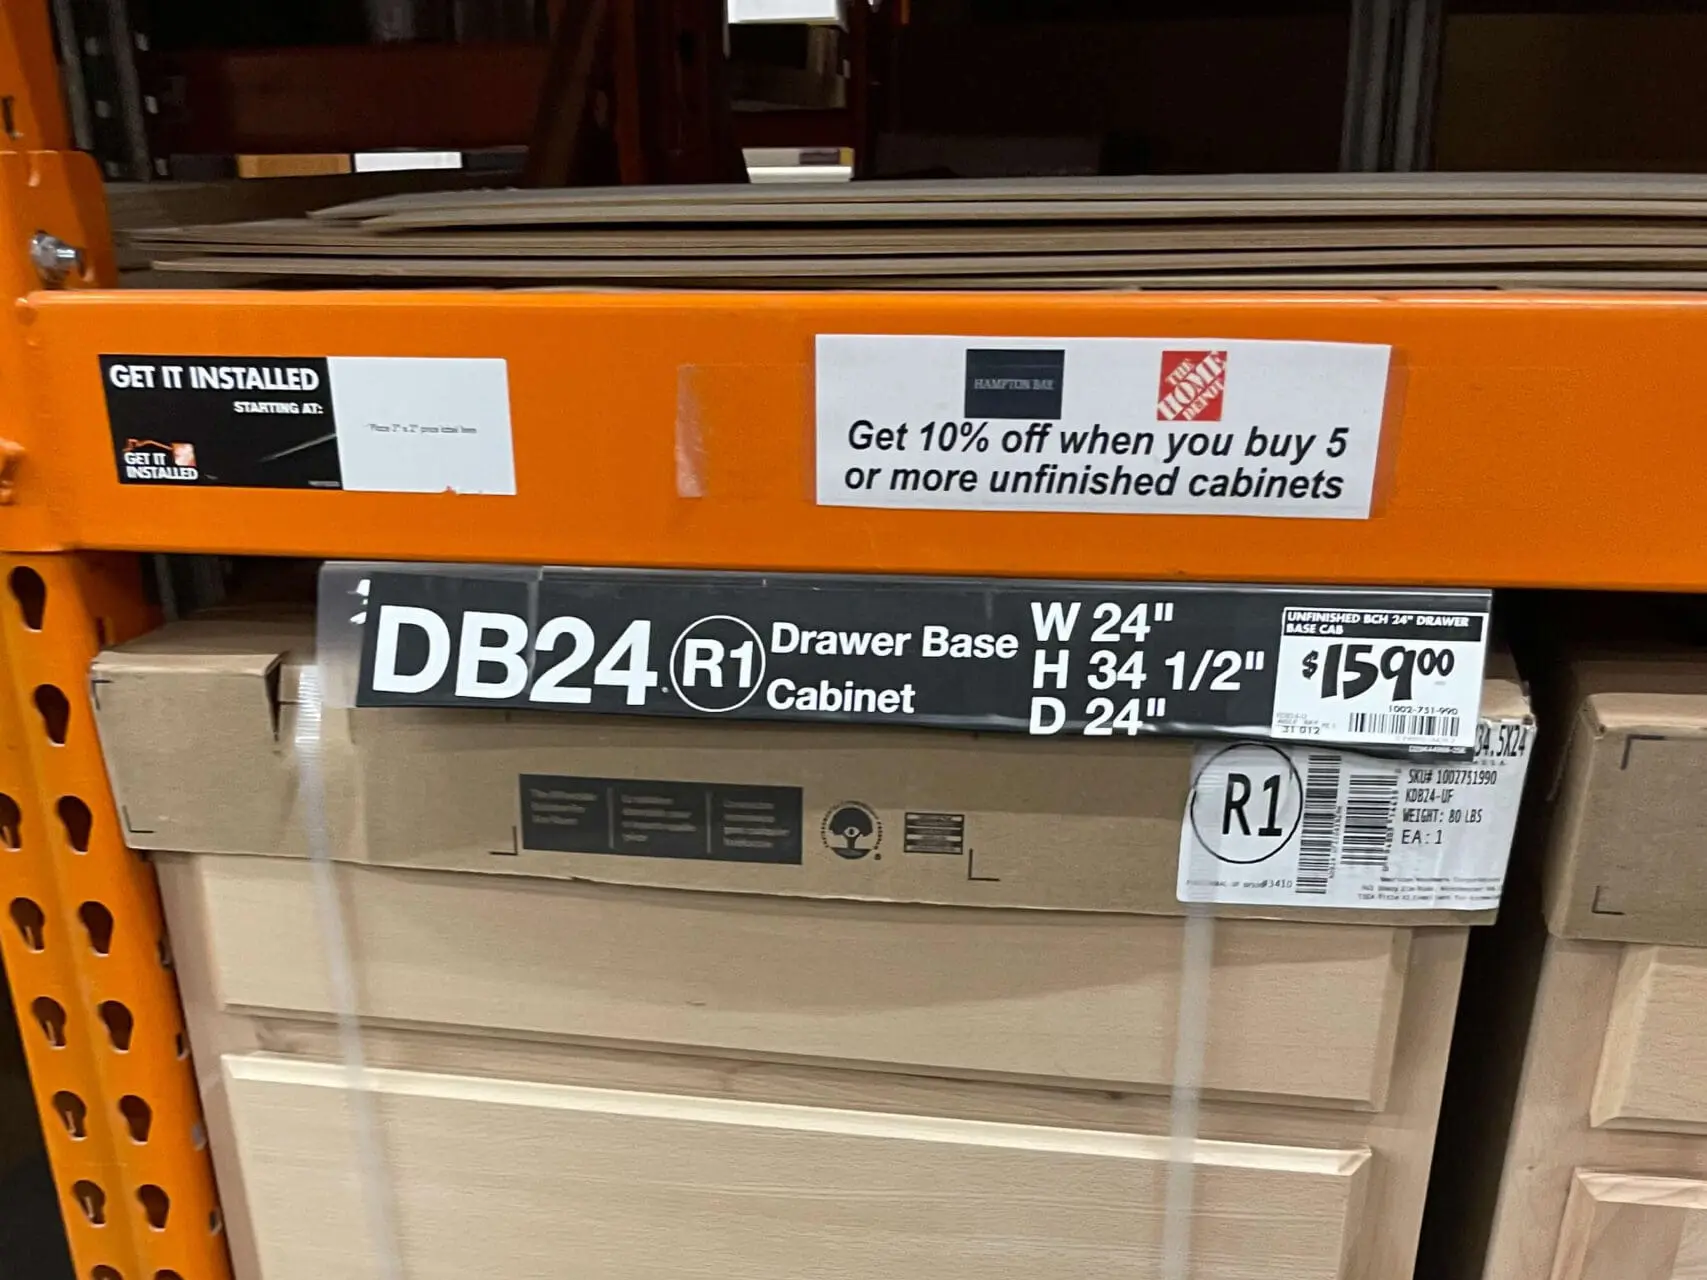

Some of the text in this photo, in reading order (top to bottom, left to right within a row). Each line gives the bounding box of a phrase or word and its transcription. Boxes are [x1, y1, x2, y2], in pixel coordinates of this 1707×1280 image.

[109, 364, 320, 391] GET IT INSTALLED
[974, 378, 1054, 390] HAMPTON BAY
[1158, 350, 1227, 421] HOME
[1166, 358, 1196, 386] THE
[233, 401, 324, 414] STARTING AT:
[1182, 380, 1225, 421] DEPOT
[124, 452, 167, 466] GET IT
[848, 420, 1349, 464] Get 10% off when you buy 5
[127, 466, 199, 481] INSTALLED
[845, 463, 1344, 499] or more unfinished cabinets
[1031, 602, 1174, 642] W 24"
[1286, 623, 1344, 635] BASE CAB
[1287, 611, 1470, 628] UNFINISHED BCH 24" DRAWER
[372, 605, 658, 706] DB24
[771, 621, 1019, 659] Drawer Base
[681, 637, 755, 689] R1
[1033, 649, 1265, 692] H 34 1/2"
[767, 679, 916, 714] Cabinet
[1029, 696, 1166, 737] D 24"
[1408, 768, 1498, 785] SKU# 1002751990
[1222, 772, 1284, 837] R1
[1402, 808, 1483, 823] WEIGHT: 80 LBS
